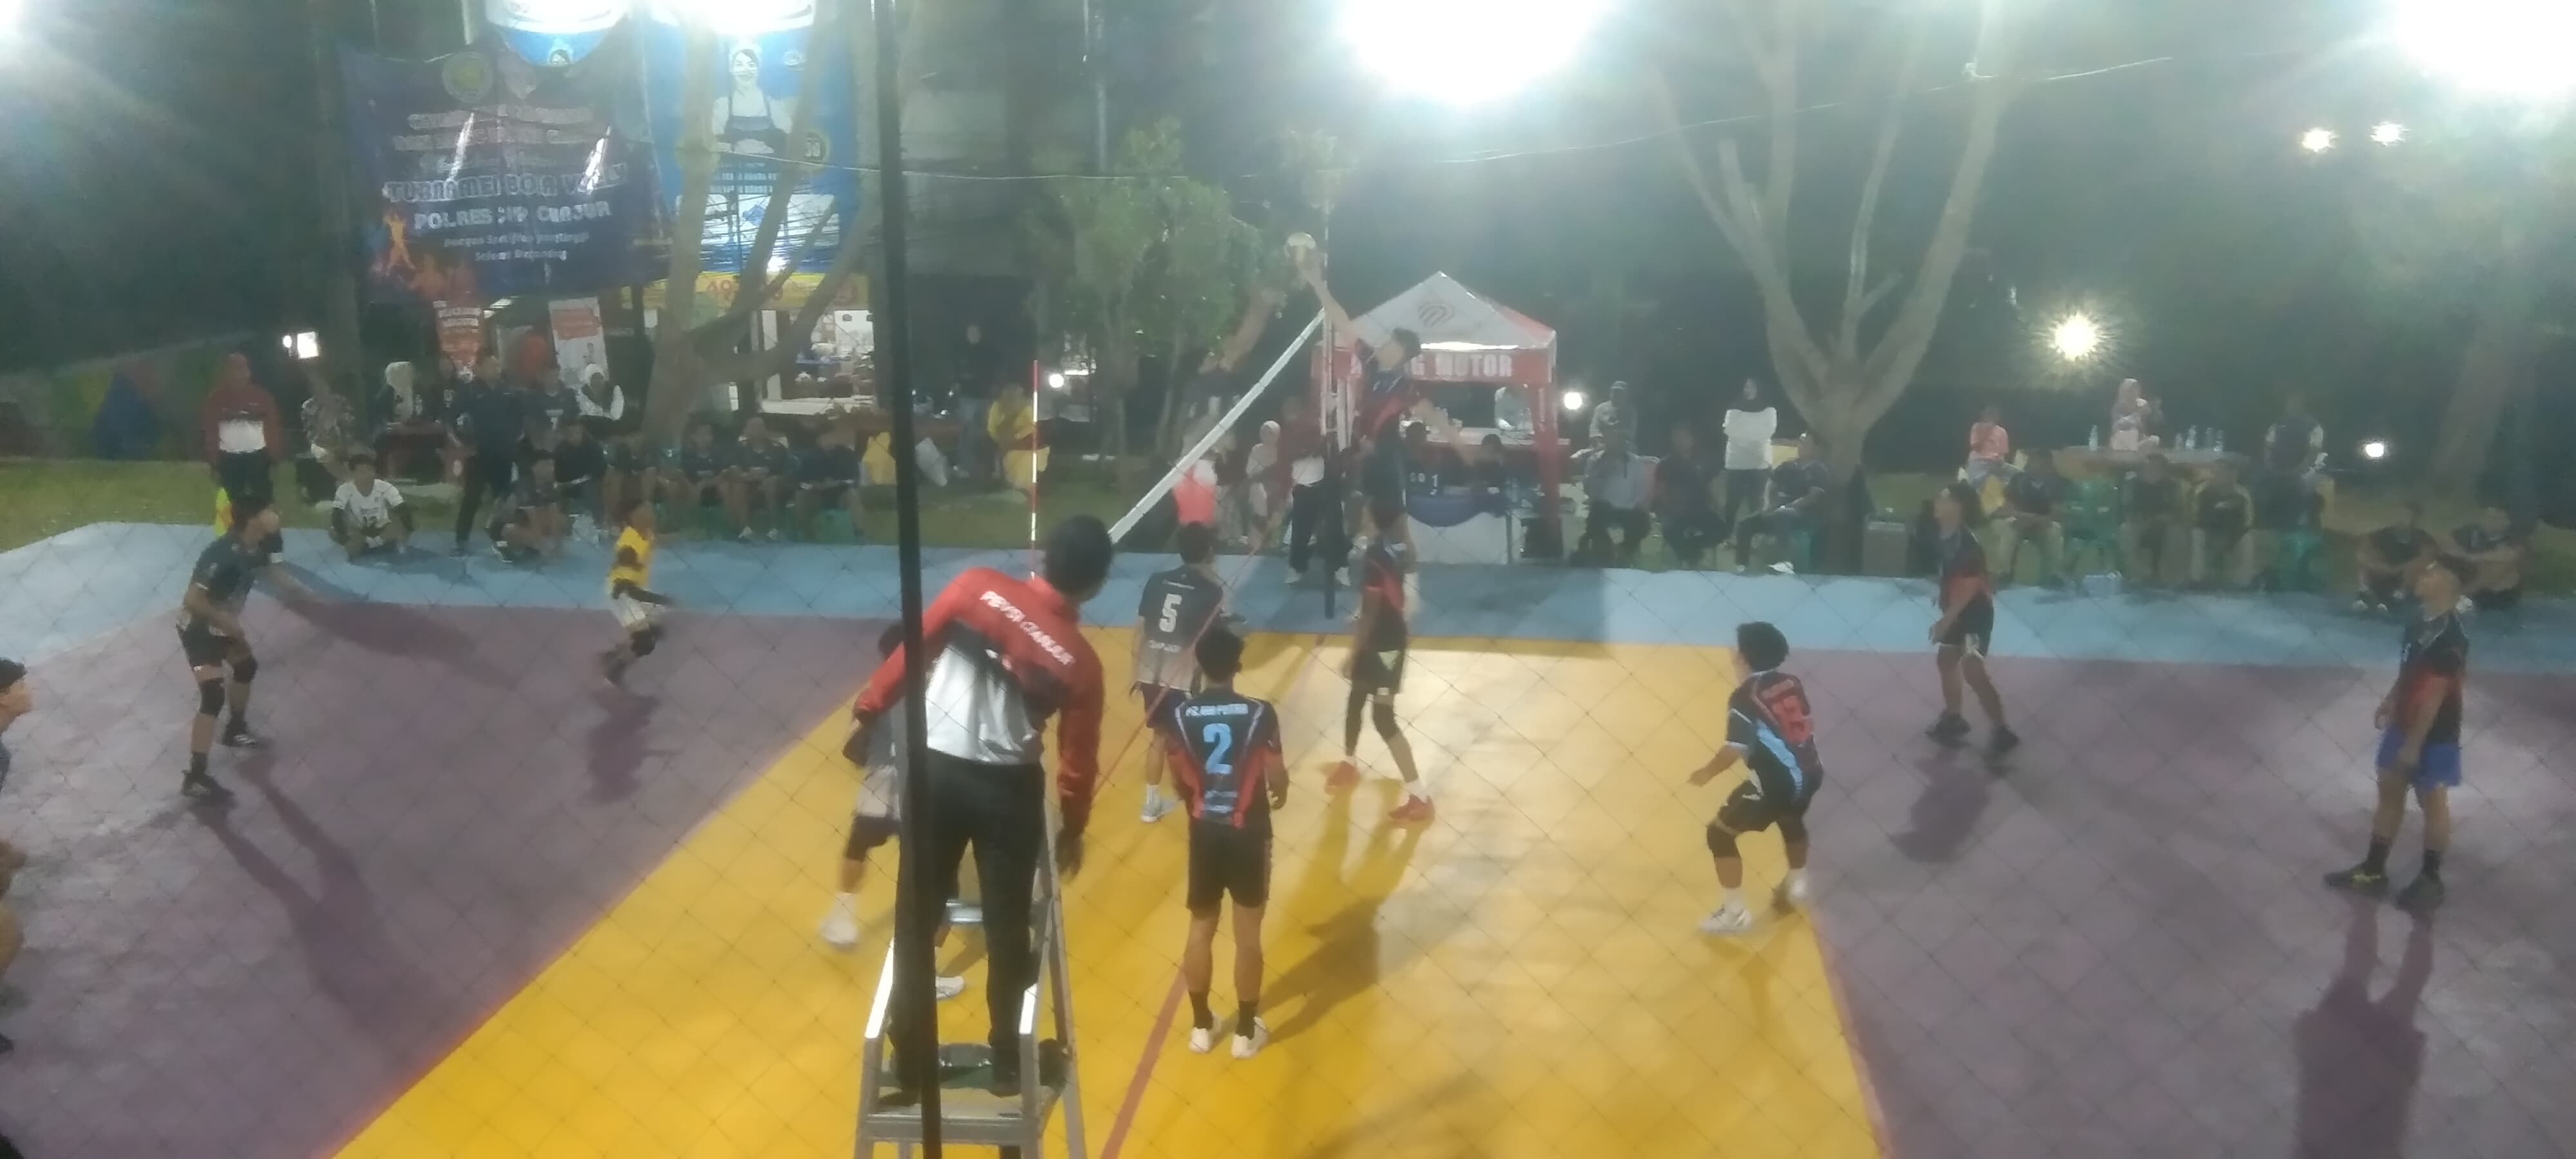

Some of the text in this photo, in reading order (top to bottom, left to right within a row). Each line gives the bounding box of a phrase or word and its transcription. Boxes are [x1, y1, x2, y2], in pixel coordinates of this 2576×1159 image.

[1435, 353, 1513, 377] MOTOR
[1159, 592, 1183, 633] 5
[1203, 722, 1233, 775] 2
